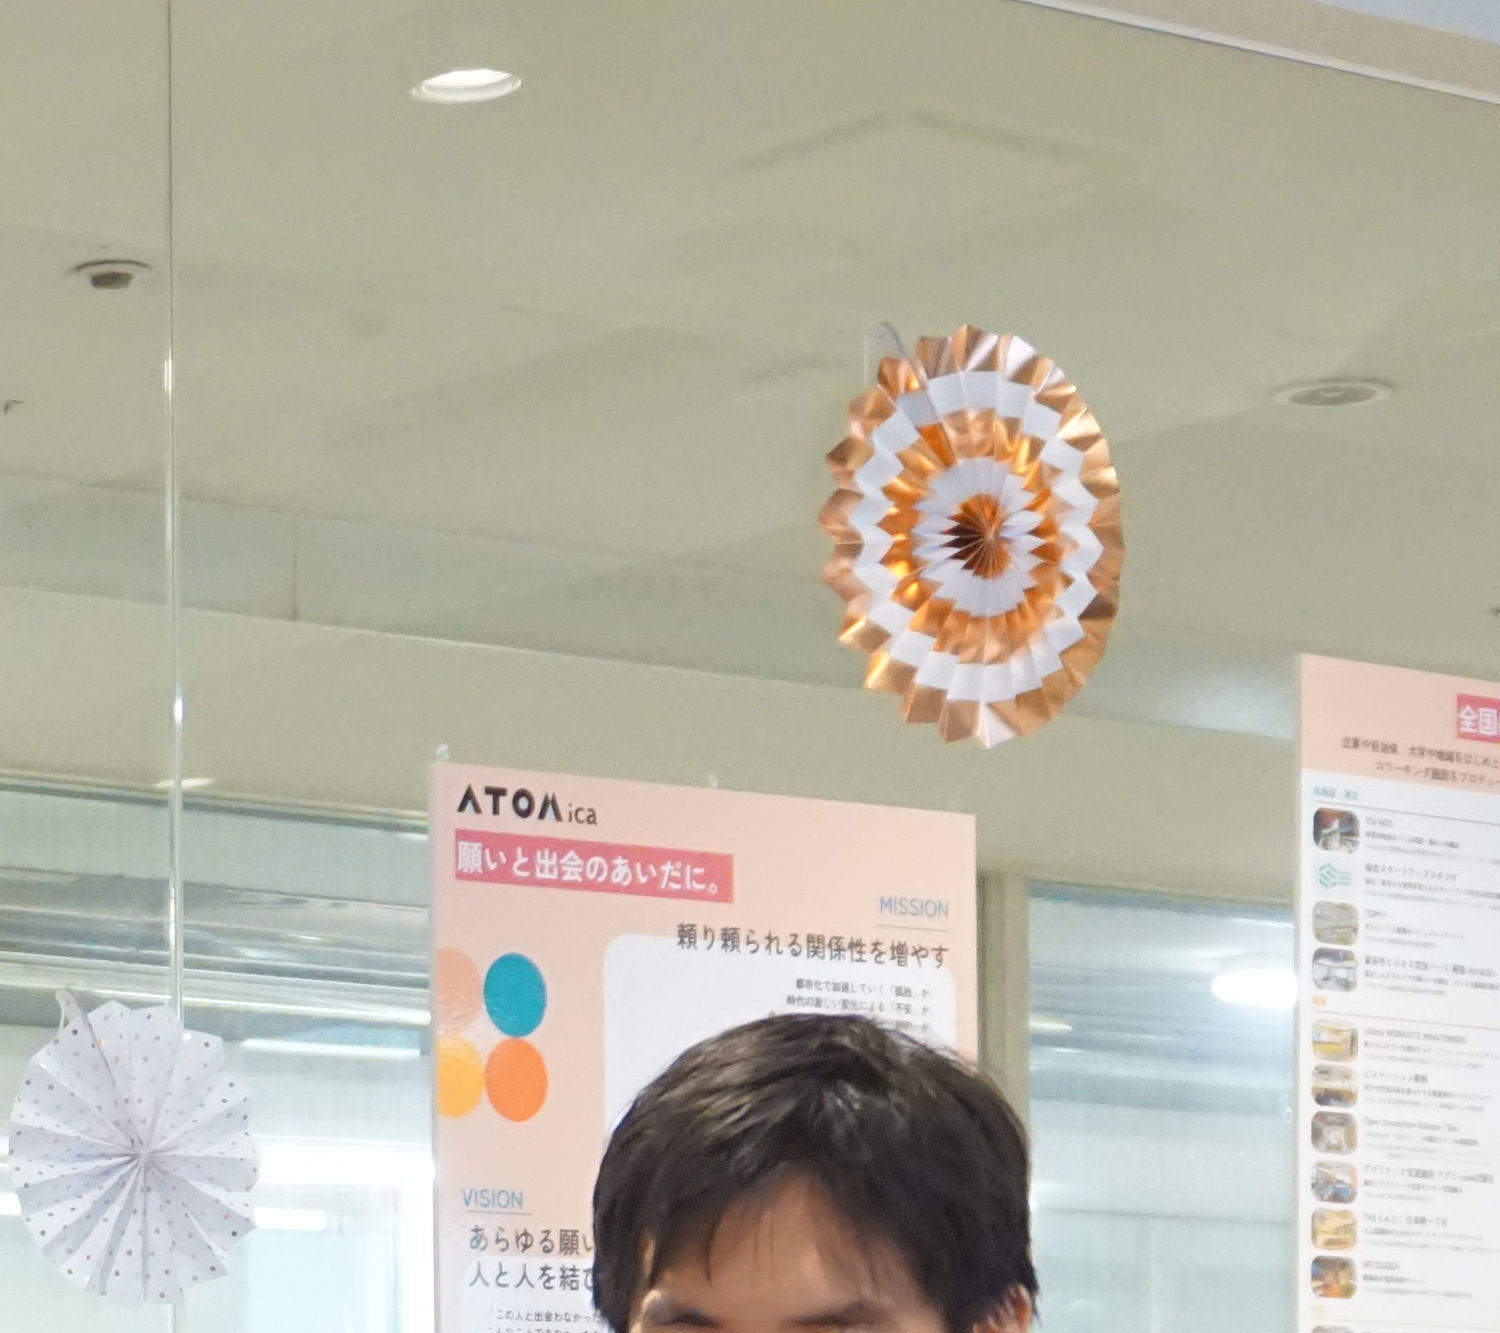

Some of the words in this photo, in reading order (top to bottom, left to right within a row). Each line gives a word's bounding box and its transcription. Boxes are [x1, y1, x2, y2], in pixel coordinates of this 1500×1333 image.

[457, 840, 721, 896] 願いと出会のあいだに。
[878, 894, 949, 920] MISSION
[676, 921, 950, 973] 頼り頼られる関係性を増やす
[461, 1186, 524, 1211] VISION
